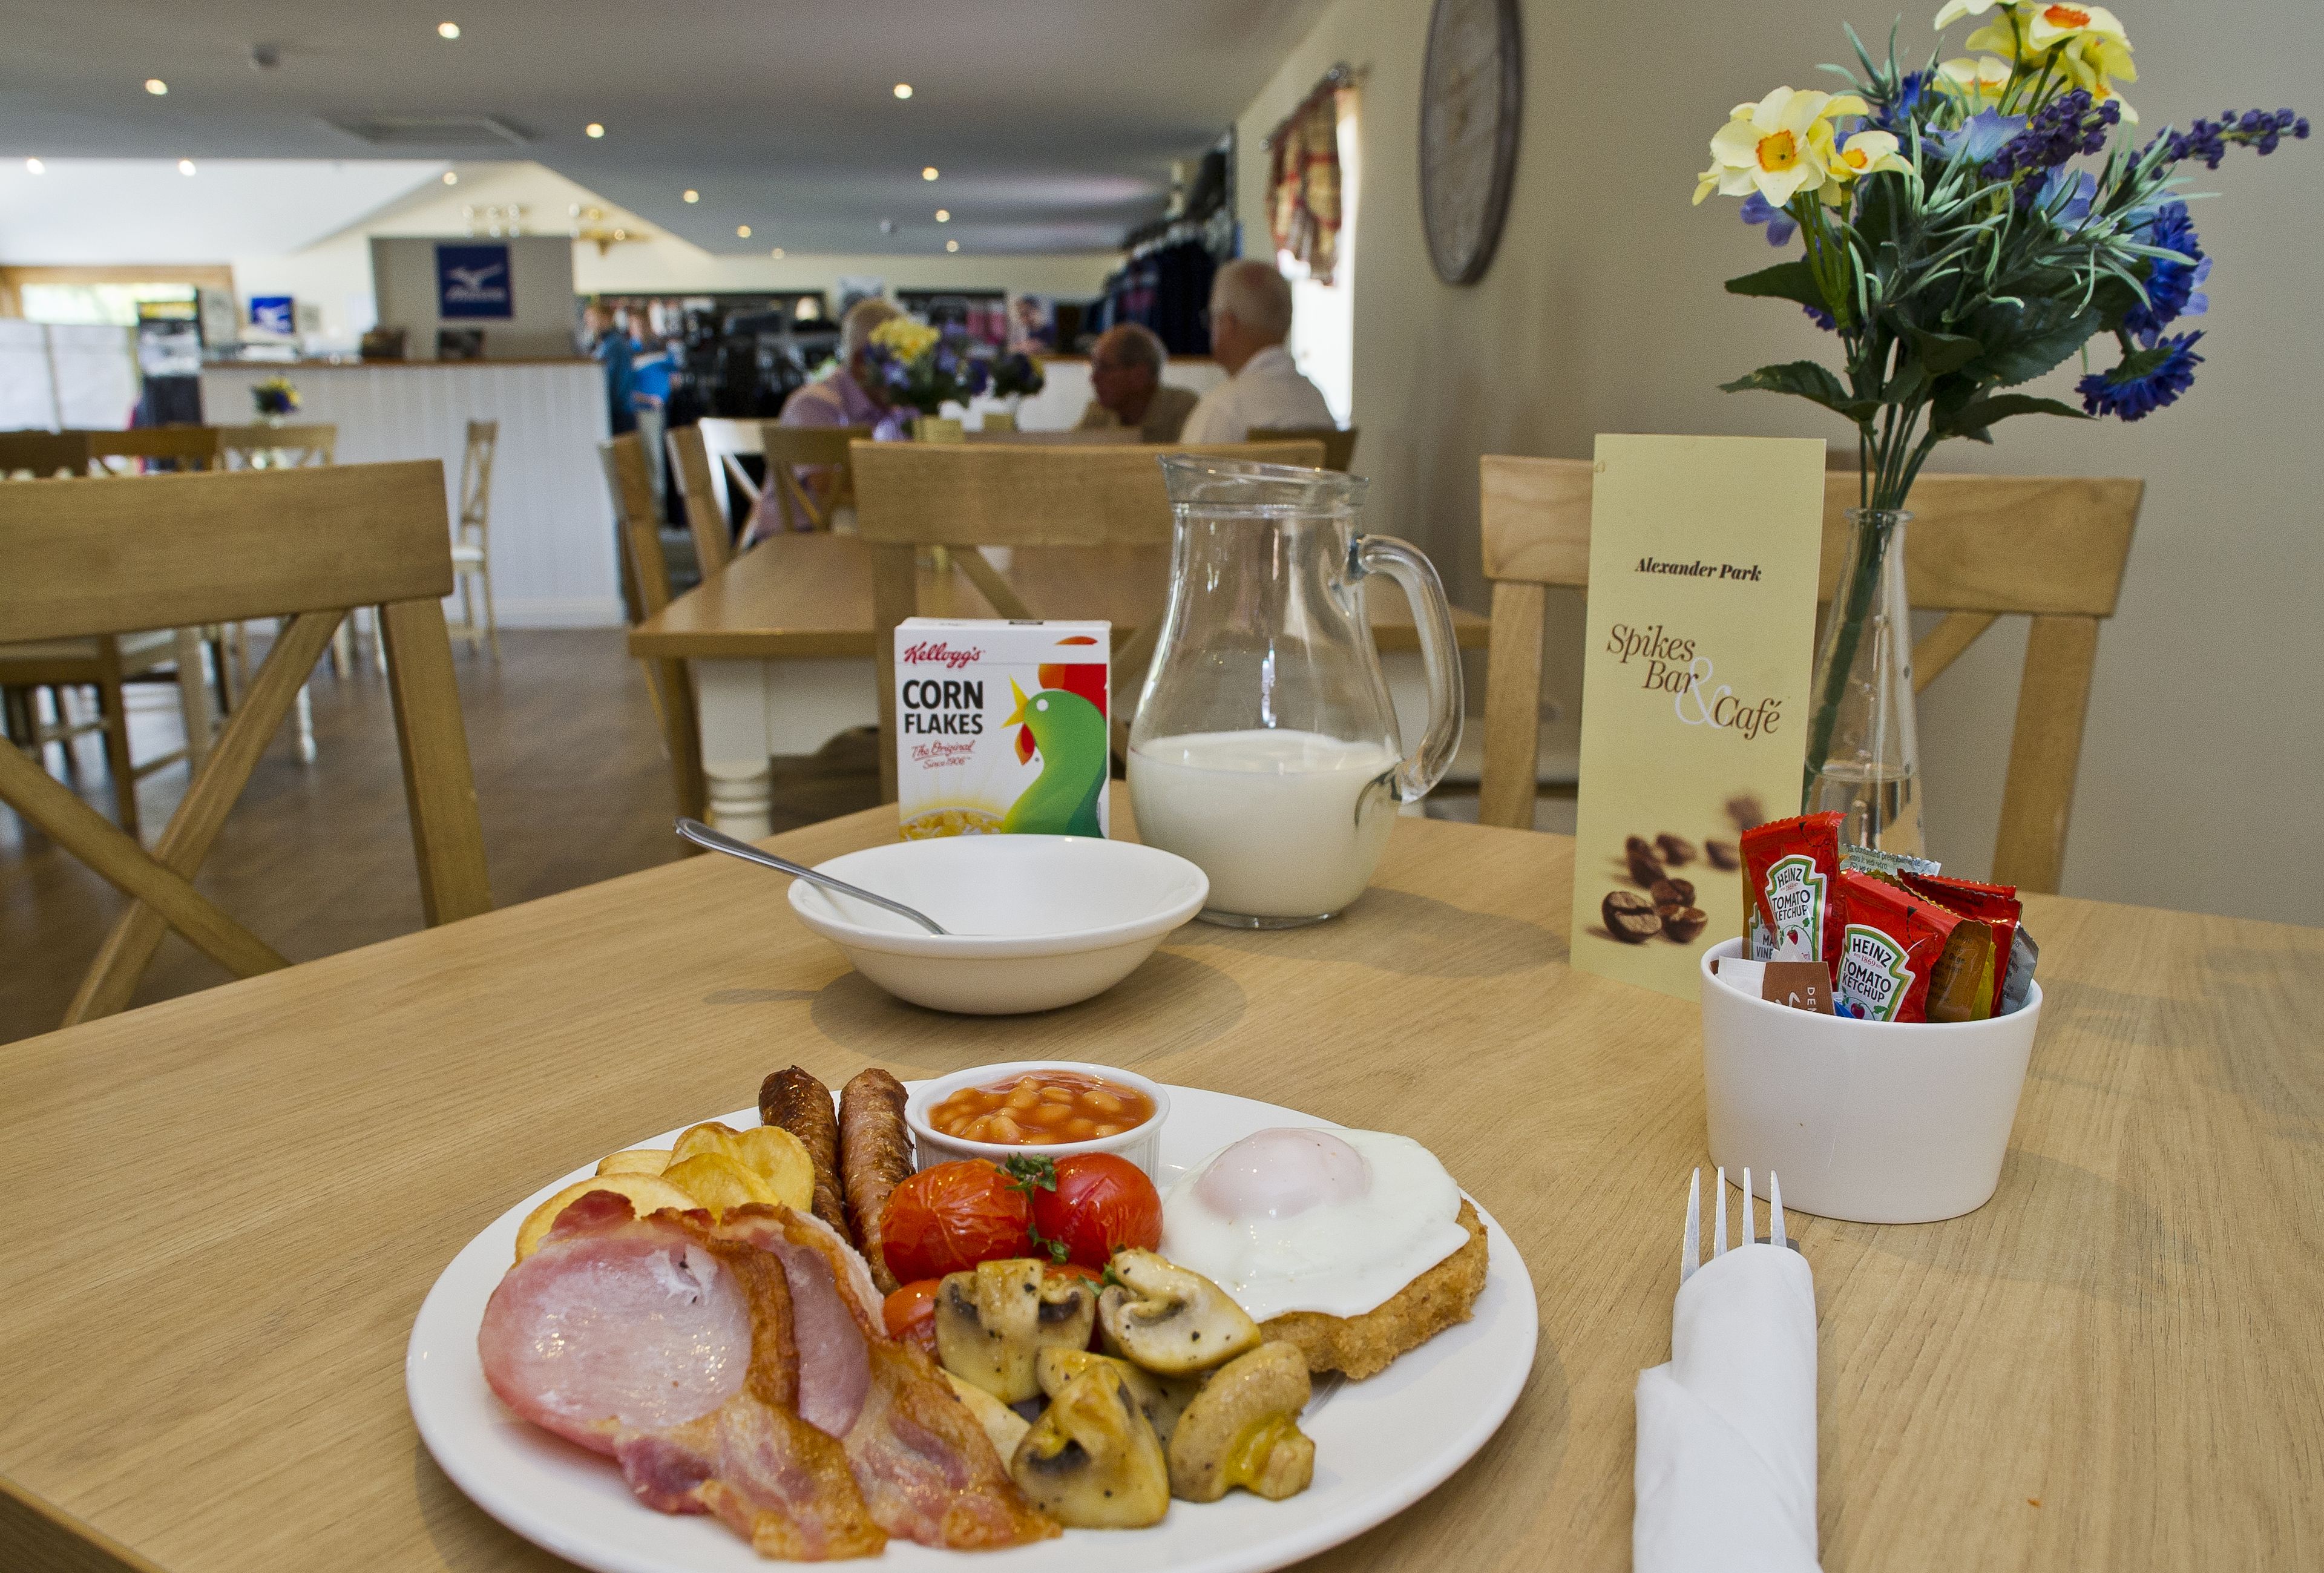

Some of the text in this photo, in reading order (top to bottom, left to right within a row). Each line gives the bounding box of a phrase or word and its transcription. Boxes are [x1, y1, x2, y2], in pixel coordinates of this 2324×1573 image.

[1635, 557, 1762, 582] Alexander Park
[904, 642, 981, 668] Kellogg's
[1606, 623, 1695, 664] Spikes
[902, 680, 983, 710] CORN
[1642, 657, 1783, 741] Bar & Café
[904, 713, 983, 735] FLAKES
[911, 739, 976, 758] The Original
[1777, 868, 1803, 888] HEINZ
[1771, 890, 1811, 911] TOMATO
[1775, 905, 1808, 922] KETCHUP
[1853, 938, 1892, 968] HEINZ
[1861, 955, 1876, 967] 1869
[1843, 957, 1891, 993] TOMATO
[1842, 974, 1885, 1003] KETCHUP
